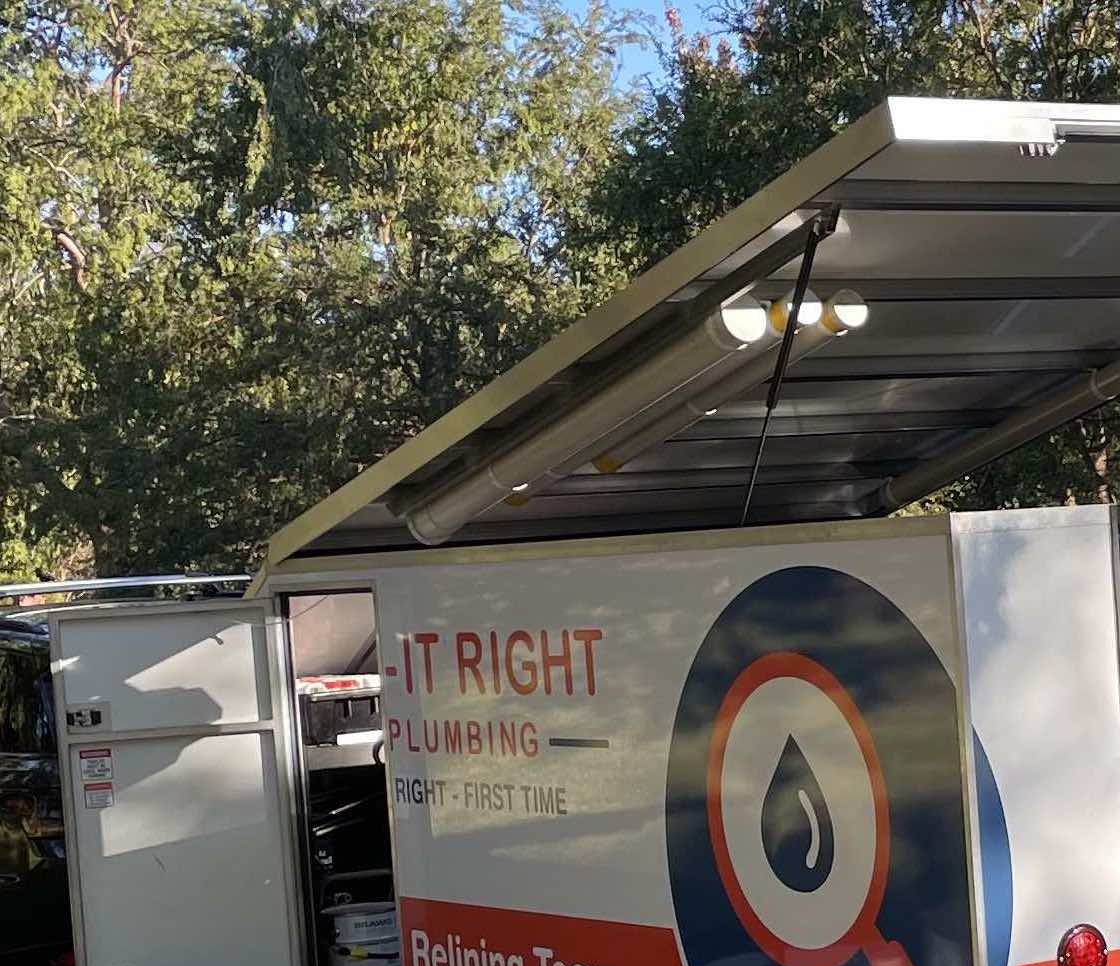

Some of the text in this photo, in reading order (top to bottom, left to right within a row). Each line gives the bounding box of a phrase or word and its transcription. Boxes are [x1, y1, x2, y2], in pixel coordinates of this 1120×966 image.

[456, 629, 602, 696] RIGHT
[388, 719, 539, 757] PLUMBING
[395, 777, 447, 806] RIGHT
[464, 781, 516, 811] FIRST
[520, 785, 568, 815] TIME
